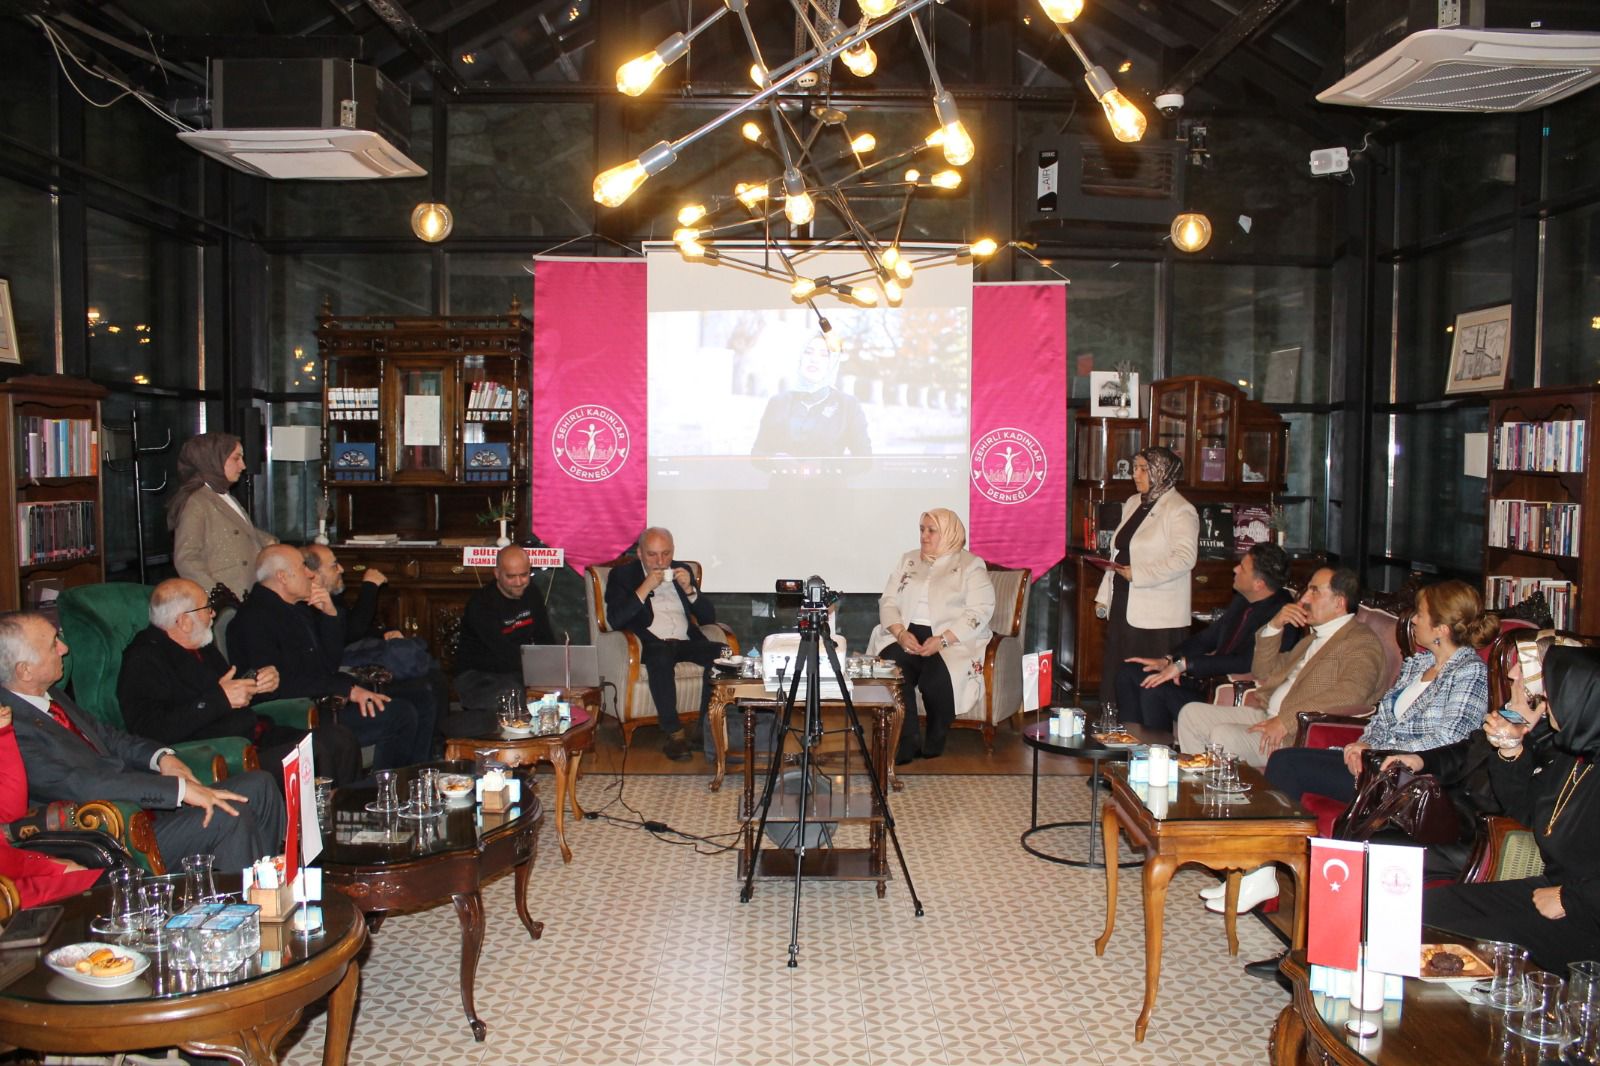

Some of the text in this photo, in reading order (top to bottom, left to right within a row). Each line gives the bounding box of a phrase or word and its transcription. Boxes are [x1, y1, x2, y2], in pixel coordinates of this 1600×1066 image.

[586, 408, 625, 439] KADINLAR
[1003, 432, 1042, 462] KADINLAR
[569, 466, 610, 478] DERNEĞİ
[986, 488, 1028, 501] DERNEĞİ
[473, 548, 498, 556] BÜLE
